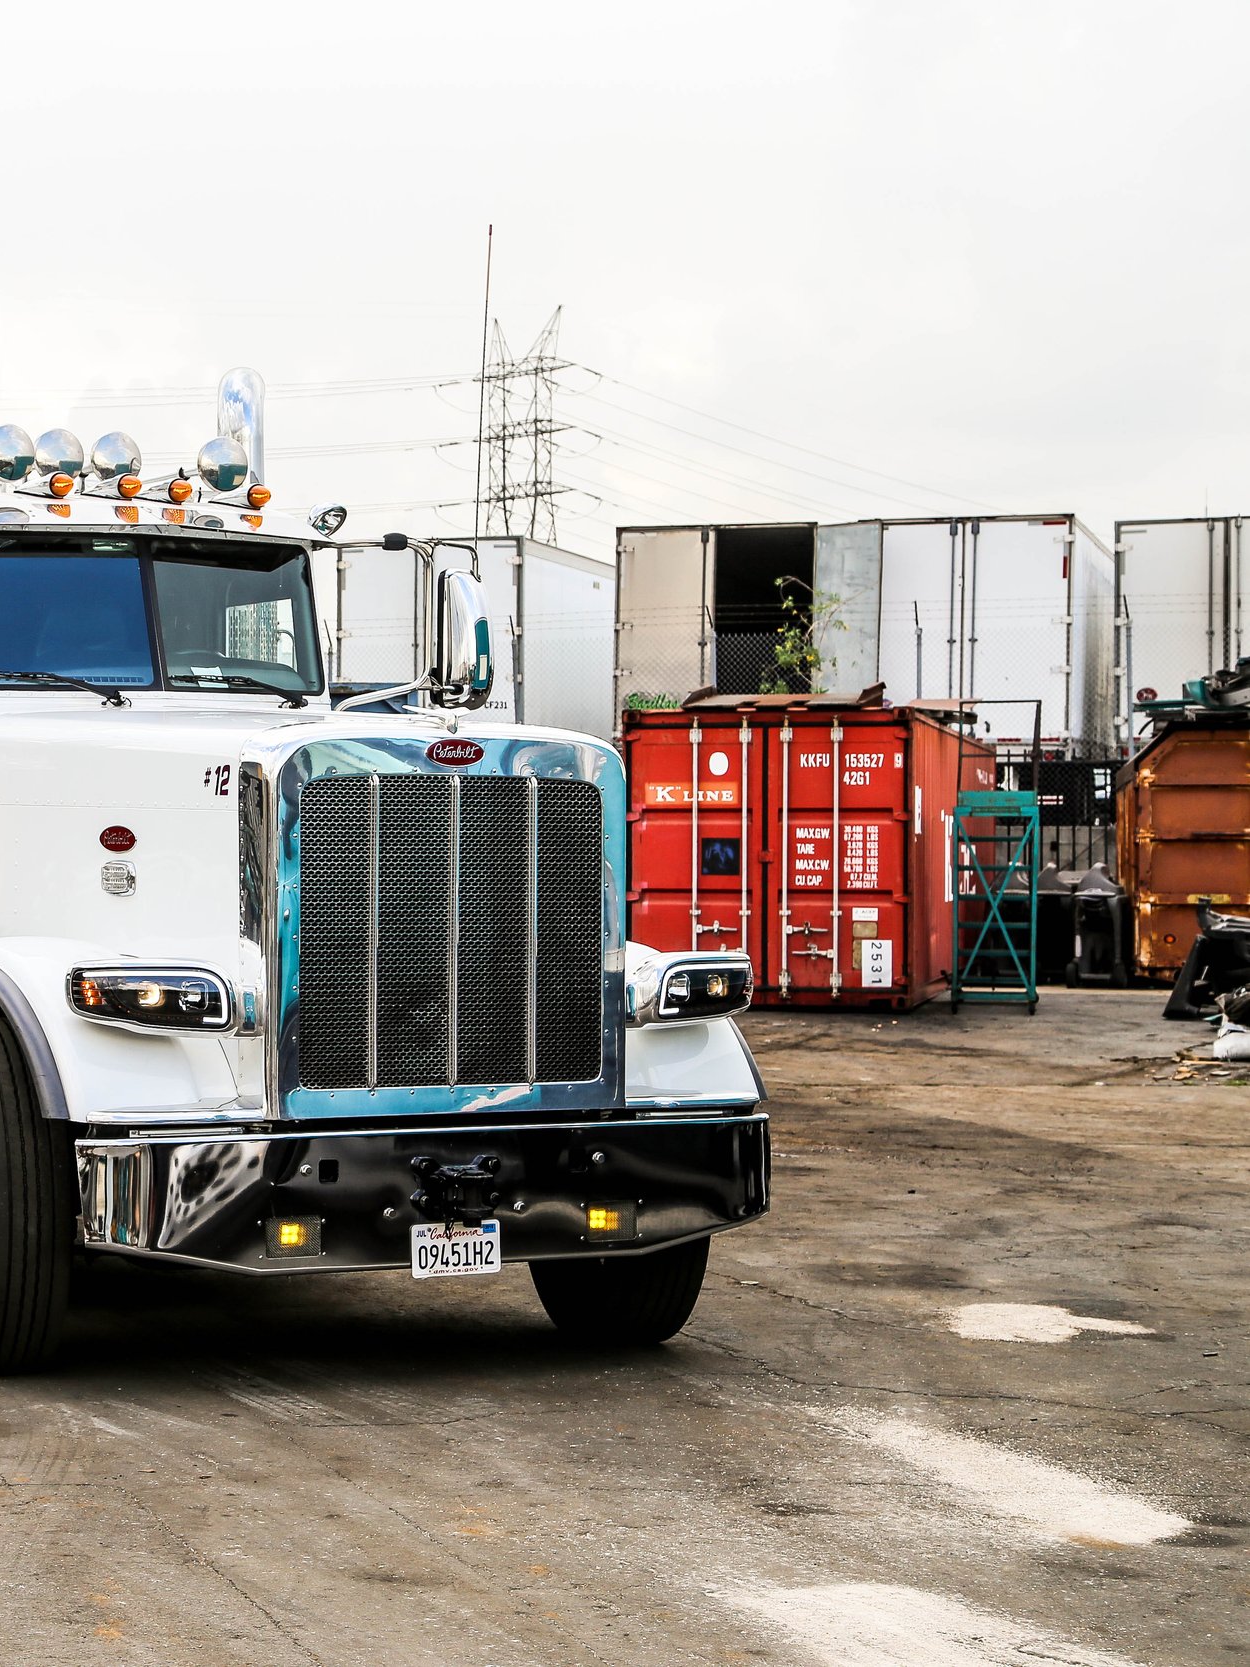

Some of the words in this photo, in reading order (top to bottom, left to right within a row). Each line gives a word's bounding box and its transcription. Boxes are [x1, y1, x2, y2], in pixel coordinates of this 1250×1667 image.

[433, 743, 480, 759] Peterbilt
[800, 753, 830, 768] KKFU
[844, 753, 884, 768] 153527
[895, 753, 902, 768] 9
[204, 764, 230, 796] #12
[843, 771, 870, 785] 42G1
[683, 790, 734, 802] LINE
[796, 844, 815, 854] TARE
[871, 942, 882, 984] 2531
[416, 1230, 426, 1238] JUL
[418, 1240, 494, 1270] 09451H2
